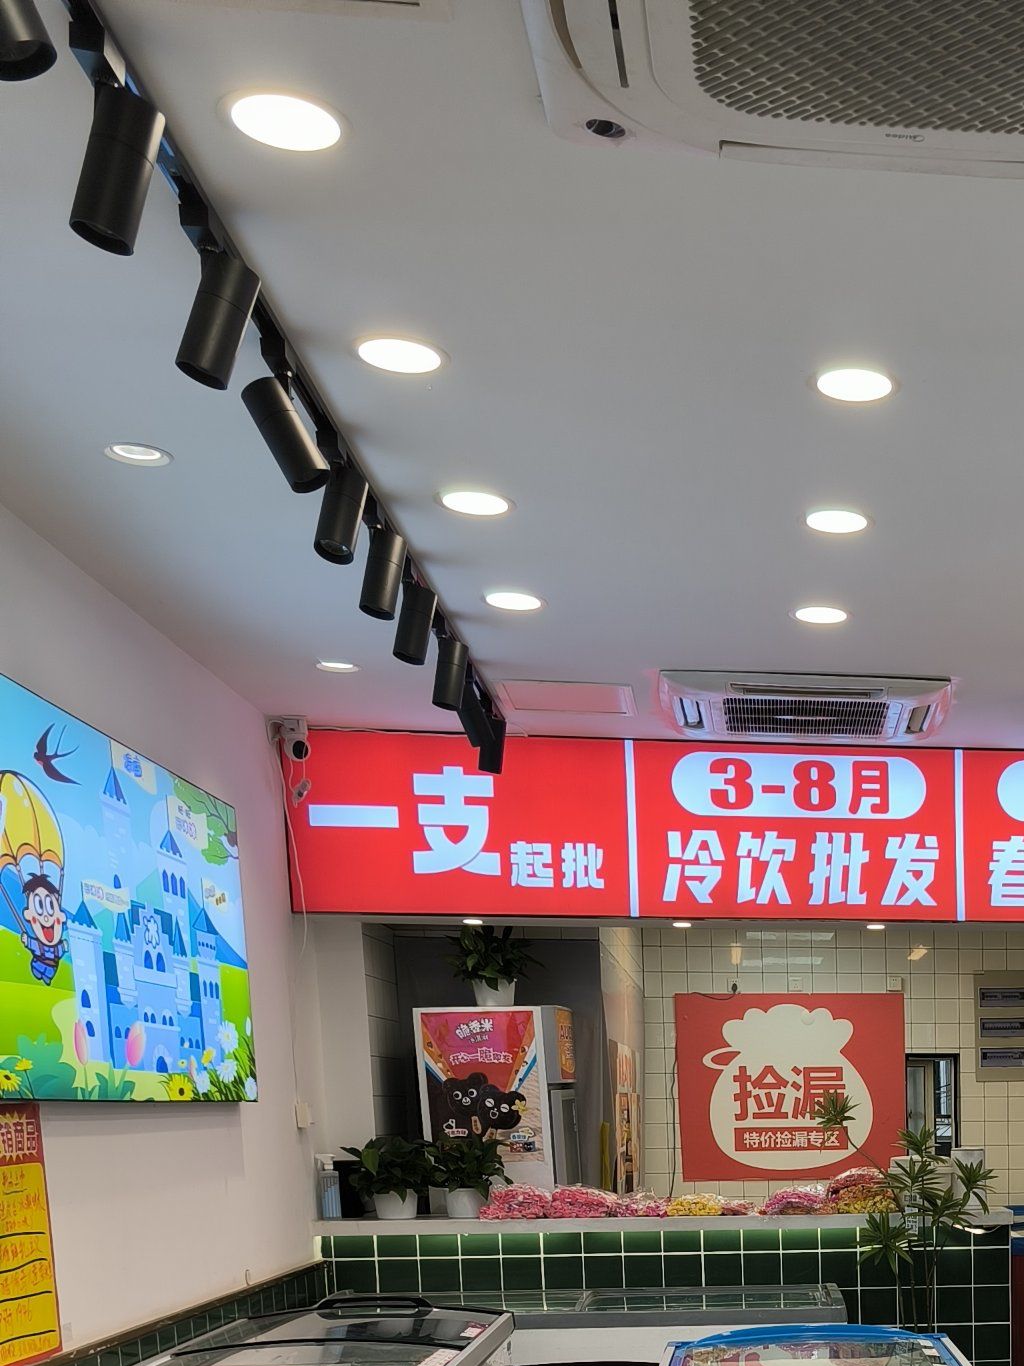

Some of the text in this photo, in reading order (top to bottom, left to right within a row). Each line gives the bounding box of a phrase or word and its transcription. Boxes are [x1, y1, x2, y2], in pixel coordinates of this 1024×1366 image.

[708, 757, 889, 815] 3-8月
[662, 829, 940, 907] 冷饮批发
[733, 1065, 847, 1122] 捡漏
[743, 1130, 841, 1149] 特价捡漏专区
